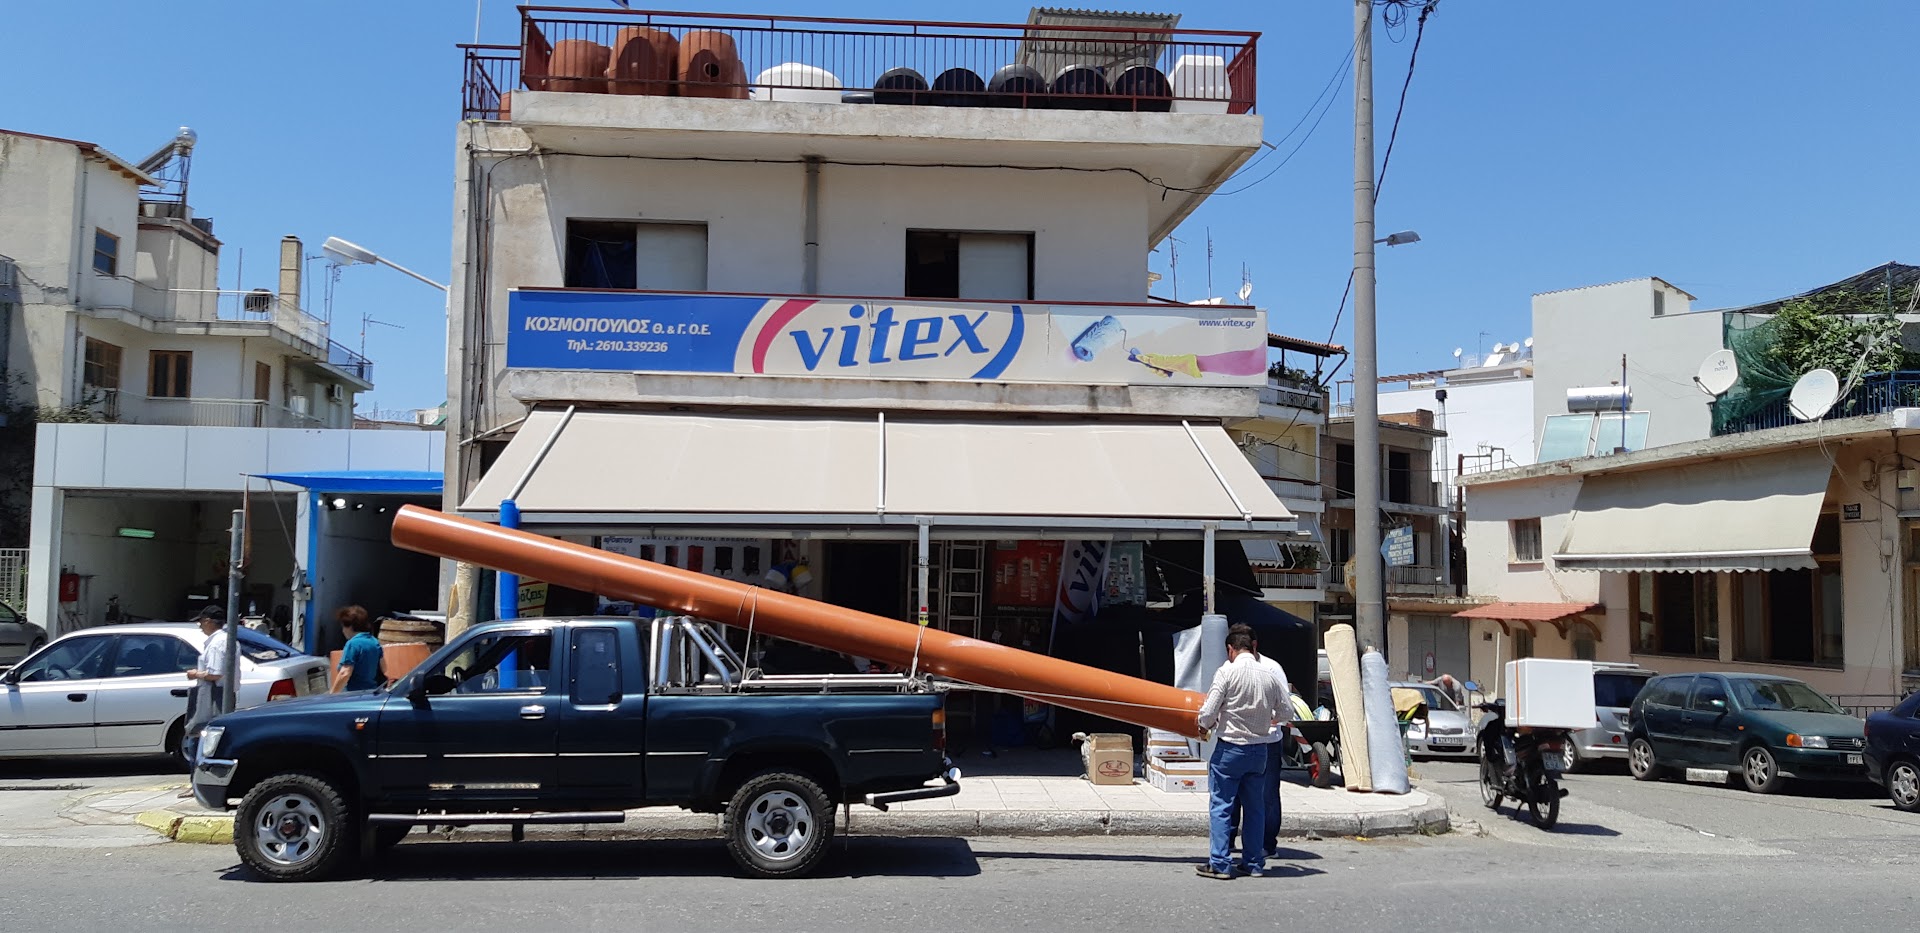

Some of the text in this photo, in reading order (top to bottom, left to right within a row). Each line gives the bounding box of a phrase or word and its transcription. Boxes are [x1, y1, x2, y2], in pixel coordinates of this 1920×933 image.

[525, 316, 711, 335] ΚΟΣΜΟΠΟΥΛΟΣ Θ. & Γ. Ο.Ε.
[1199, 318, 1255, 329] www.vitex.gr
[789, 304, 990, 371] vitex
[567, 339, 668, 353] Τηλ.: 2610.339236
